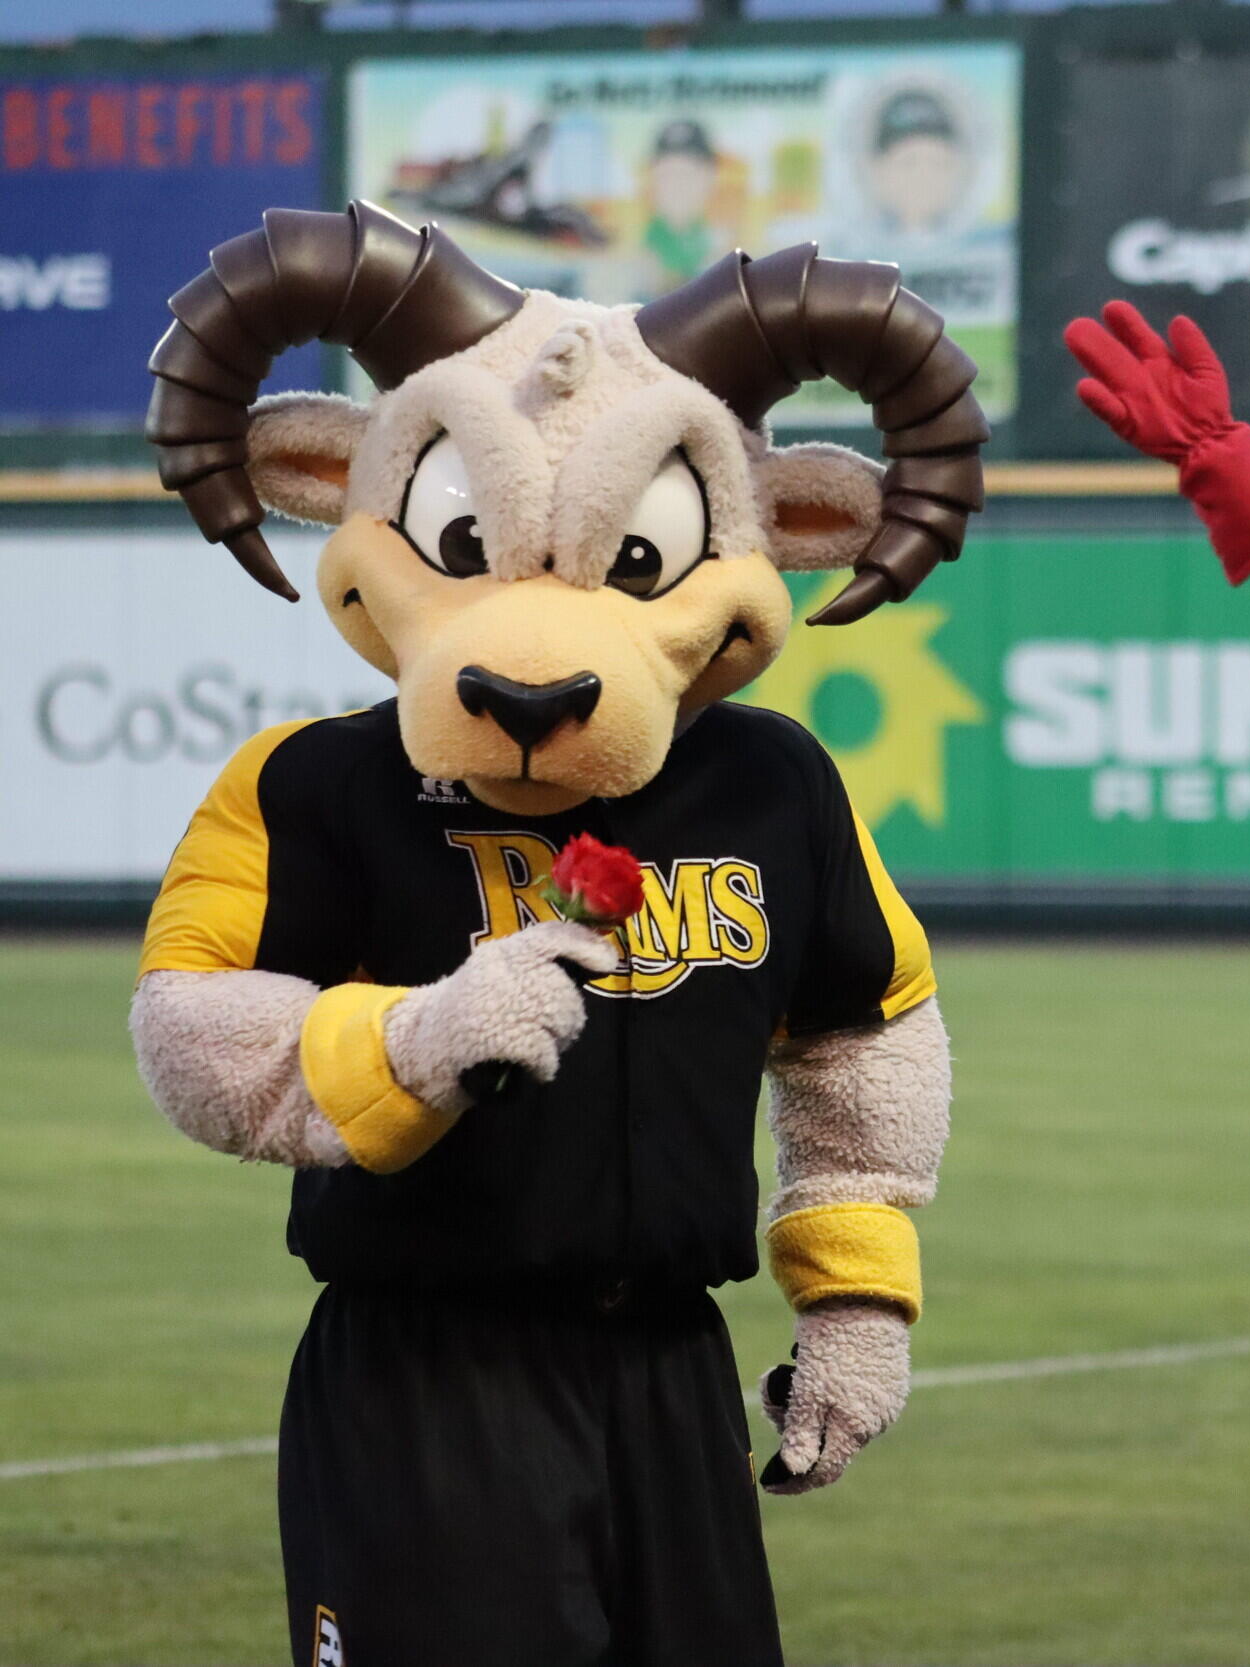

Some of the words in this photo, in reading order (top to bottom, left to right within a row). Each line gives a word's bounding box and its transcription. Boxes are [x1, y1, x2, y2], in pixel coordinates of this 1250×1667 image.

[2, 80, 313, 170] BENEFITS
[34, 660, 366, 765] CoSt
[445, 829, 770, 985] RMS
